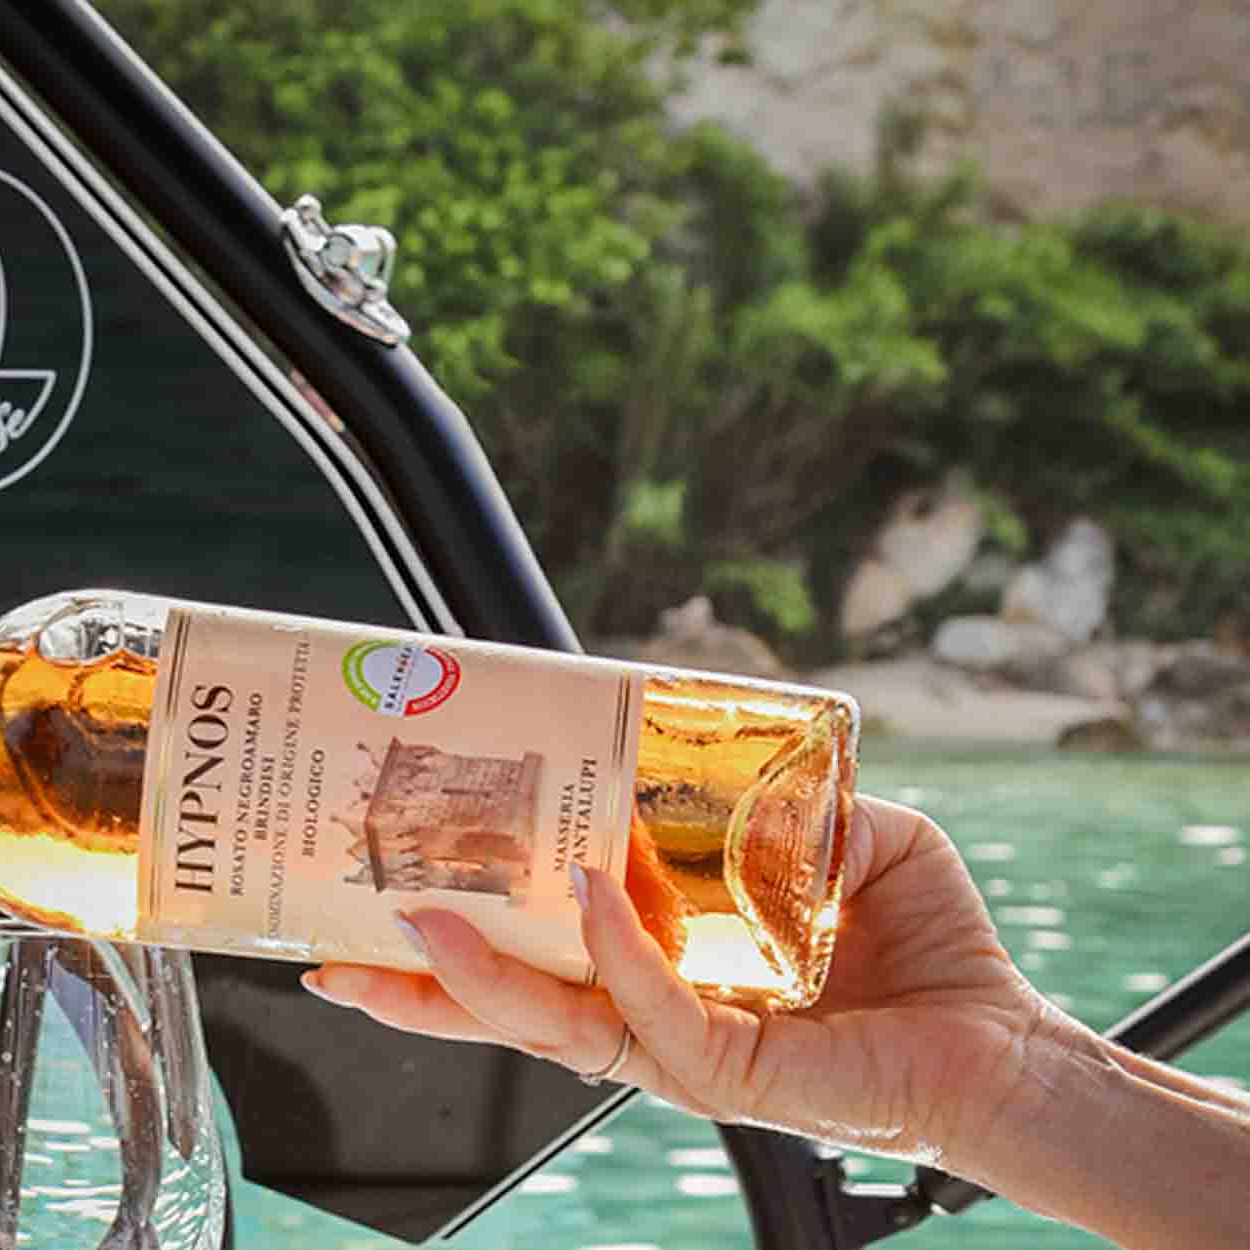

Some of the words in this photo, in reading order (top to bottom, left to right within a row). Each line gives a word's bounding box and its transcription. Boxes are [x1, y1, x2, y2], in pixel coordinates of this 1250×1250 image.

[174, 684, 234, 894] HYPNOS
[237, 691, 264, 823] NEGROAMARO
[254, 756, 275, 841] BRINDISI
[277, 719, 301, 799] ORIGINE
[301, 749, 326, 858] BIOLOGICO
[552, 783, 576, 873] MASSERIA
[572, 757, 598, 864] ANTALUPI
[230, 829, 248, 896] ROSATO
